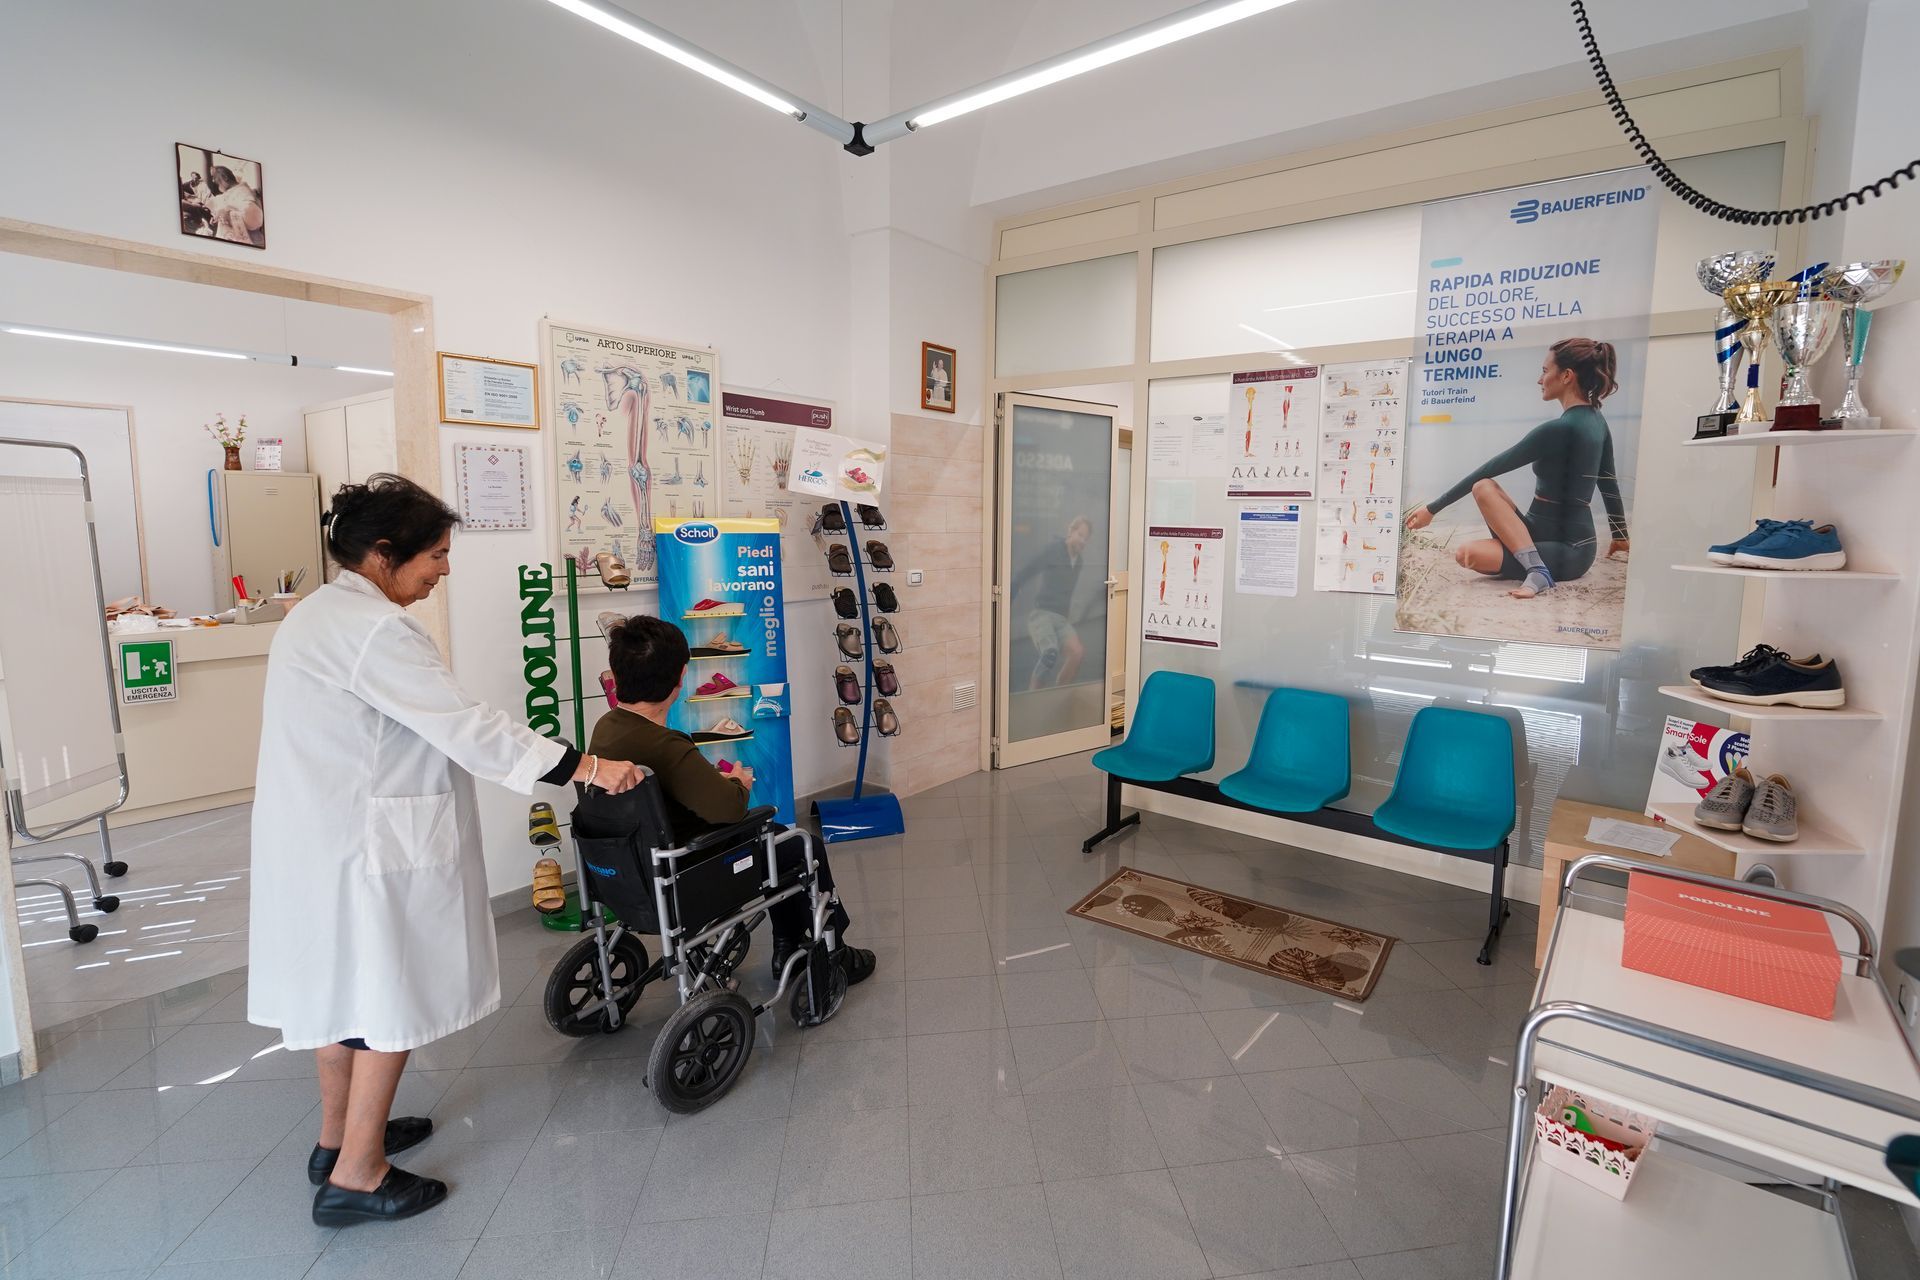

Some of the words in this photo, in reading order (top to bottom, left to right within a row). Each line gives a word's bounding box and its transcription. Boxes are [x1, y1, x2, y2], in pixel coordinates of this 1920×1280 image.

[1541, 187, 1646, 216] BAUERFEIND
[1429, 272, 1494, 293] RAPIDA
[1500, 258, 1601, 285] RIDUZIONE
[1428, 296, 1459, 311] DEL
[1465, 286, 1538, 307] DOLORE,
[1426, 306, 1515, 329] SUCCESSO
[1522, 300, 1583, 320] NELLA
[1425, 328, 1496, 347] TERAPIA
[1502, 326, 1514, 341] A
[597, 338, 624, 351] ARTO
[626, 343, 677, 360] SUPERIORE
[1424, 347, 1483, 365] LUNGO
[1423, 364, 1503, 383] TERMINE.
[1421, 397, 1429, 405] di
[1431, 396, 1476, 405] Bauerfeind
[1422, 387, 1445, 396] Tutori
[1447, 387, 1468, 395] Train
[725, 405, 739, 413] Wrist
[749, 408, 765, 416] Thumb
[680, 527, 715, 538] Scholl
[737, 545, 774, 558] Piedi
[737, 560, 774, 577] sani
[709, 578, 775, 592] lavorano
[759, 595, 780, 657] meglio
[518, 563, 560, 738] ODOLINE
[126, 691, 173, 701] EMERGENZA
[131, 686, 158, 695] USCITA
[1665, 726, 1707, 745] SmartSole
[1677, 892, 1772, 919] PODOLINE
